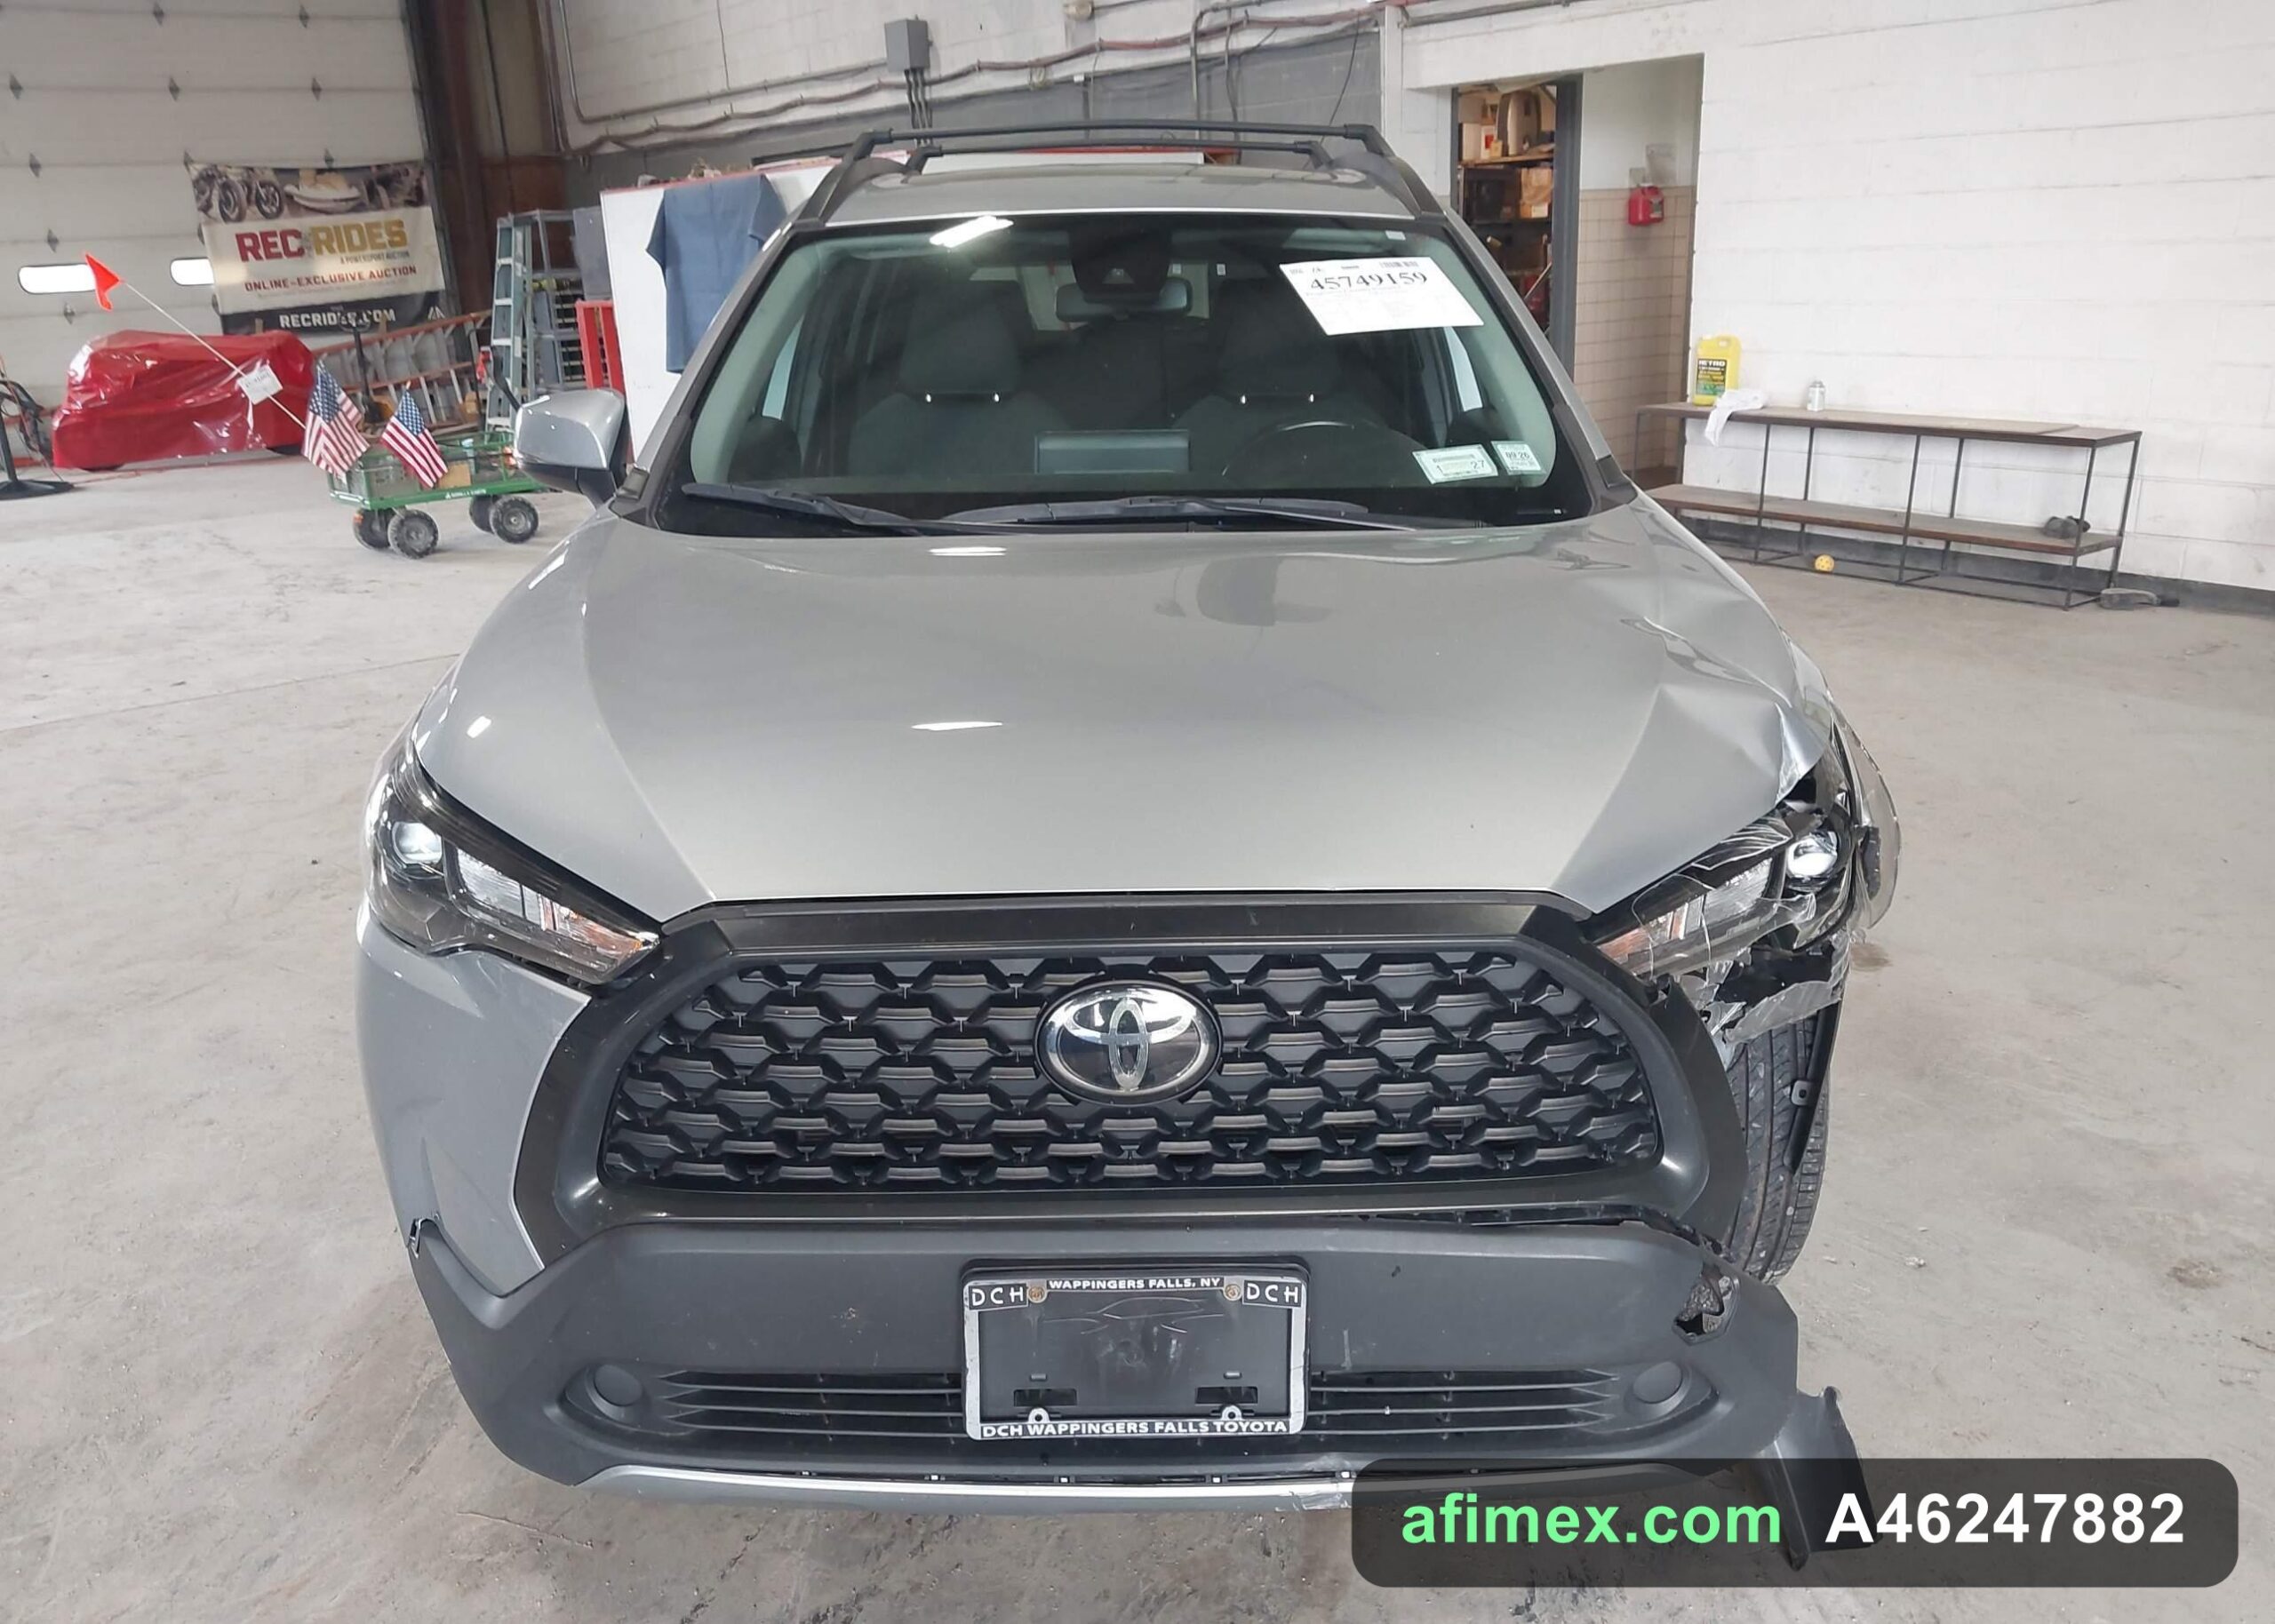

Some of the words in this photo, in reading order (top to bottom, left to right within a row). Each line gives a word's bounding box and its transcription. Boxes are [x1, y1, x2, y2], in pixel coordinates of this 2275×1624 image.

[235, 228, 306, 263] REC
[308, 219, 409, 256] RIDES
[244, 270, 365, 292] ONLINE-EXCLUSIVE
[369, 265, 418, 282] AUCTION
[1310, 271, 1427, 291] 45749159
[1049, 1279, 1145, 1289] WAPPINGERS
[1148, 1278, 1196, 1289] FALLS,
[1201, 1278, 1221, 1286] NY
[1247, 1283, 1299, 1303] DCH
[971, 1286, 1024, 1306] DCH
[982, 1424, 1023, 1437] DCH
[1026, 1422, 1149, 1436] WAPPINGERS
[1154, 1421, 1209, 1433] FALLS
[1213, 1421, 1288, 1433] TOYOTA
